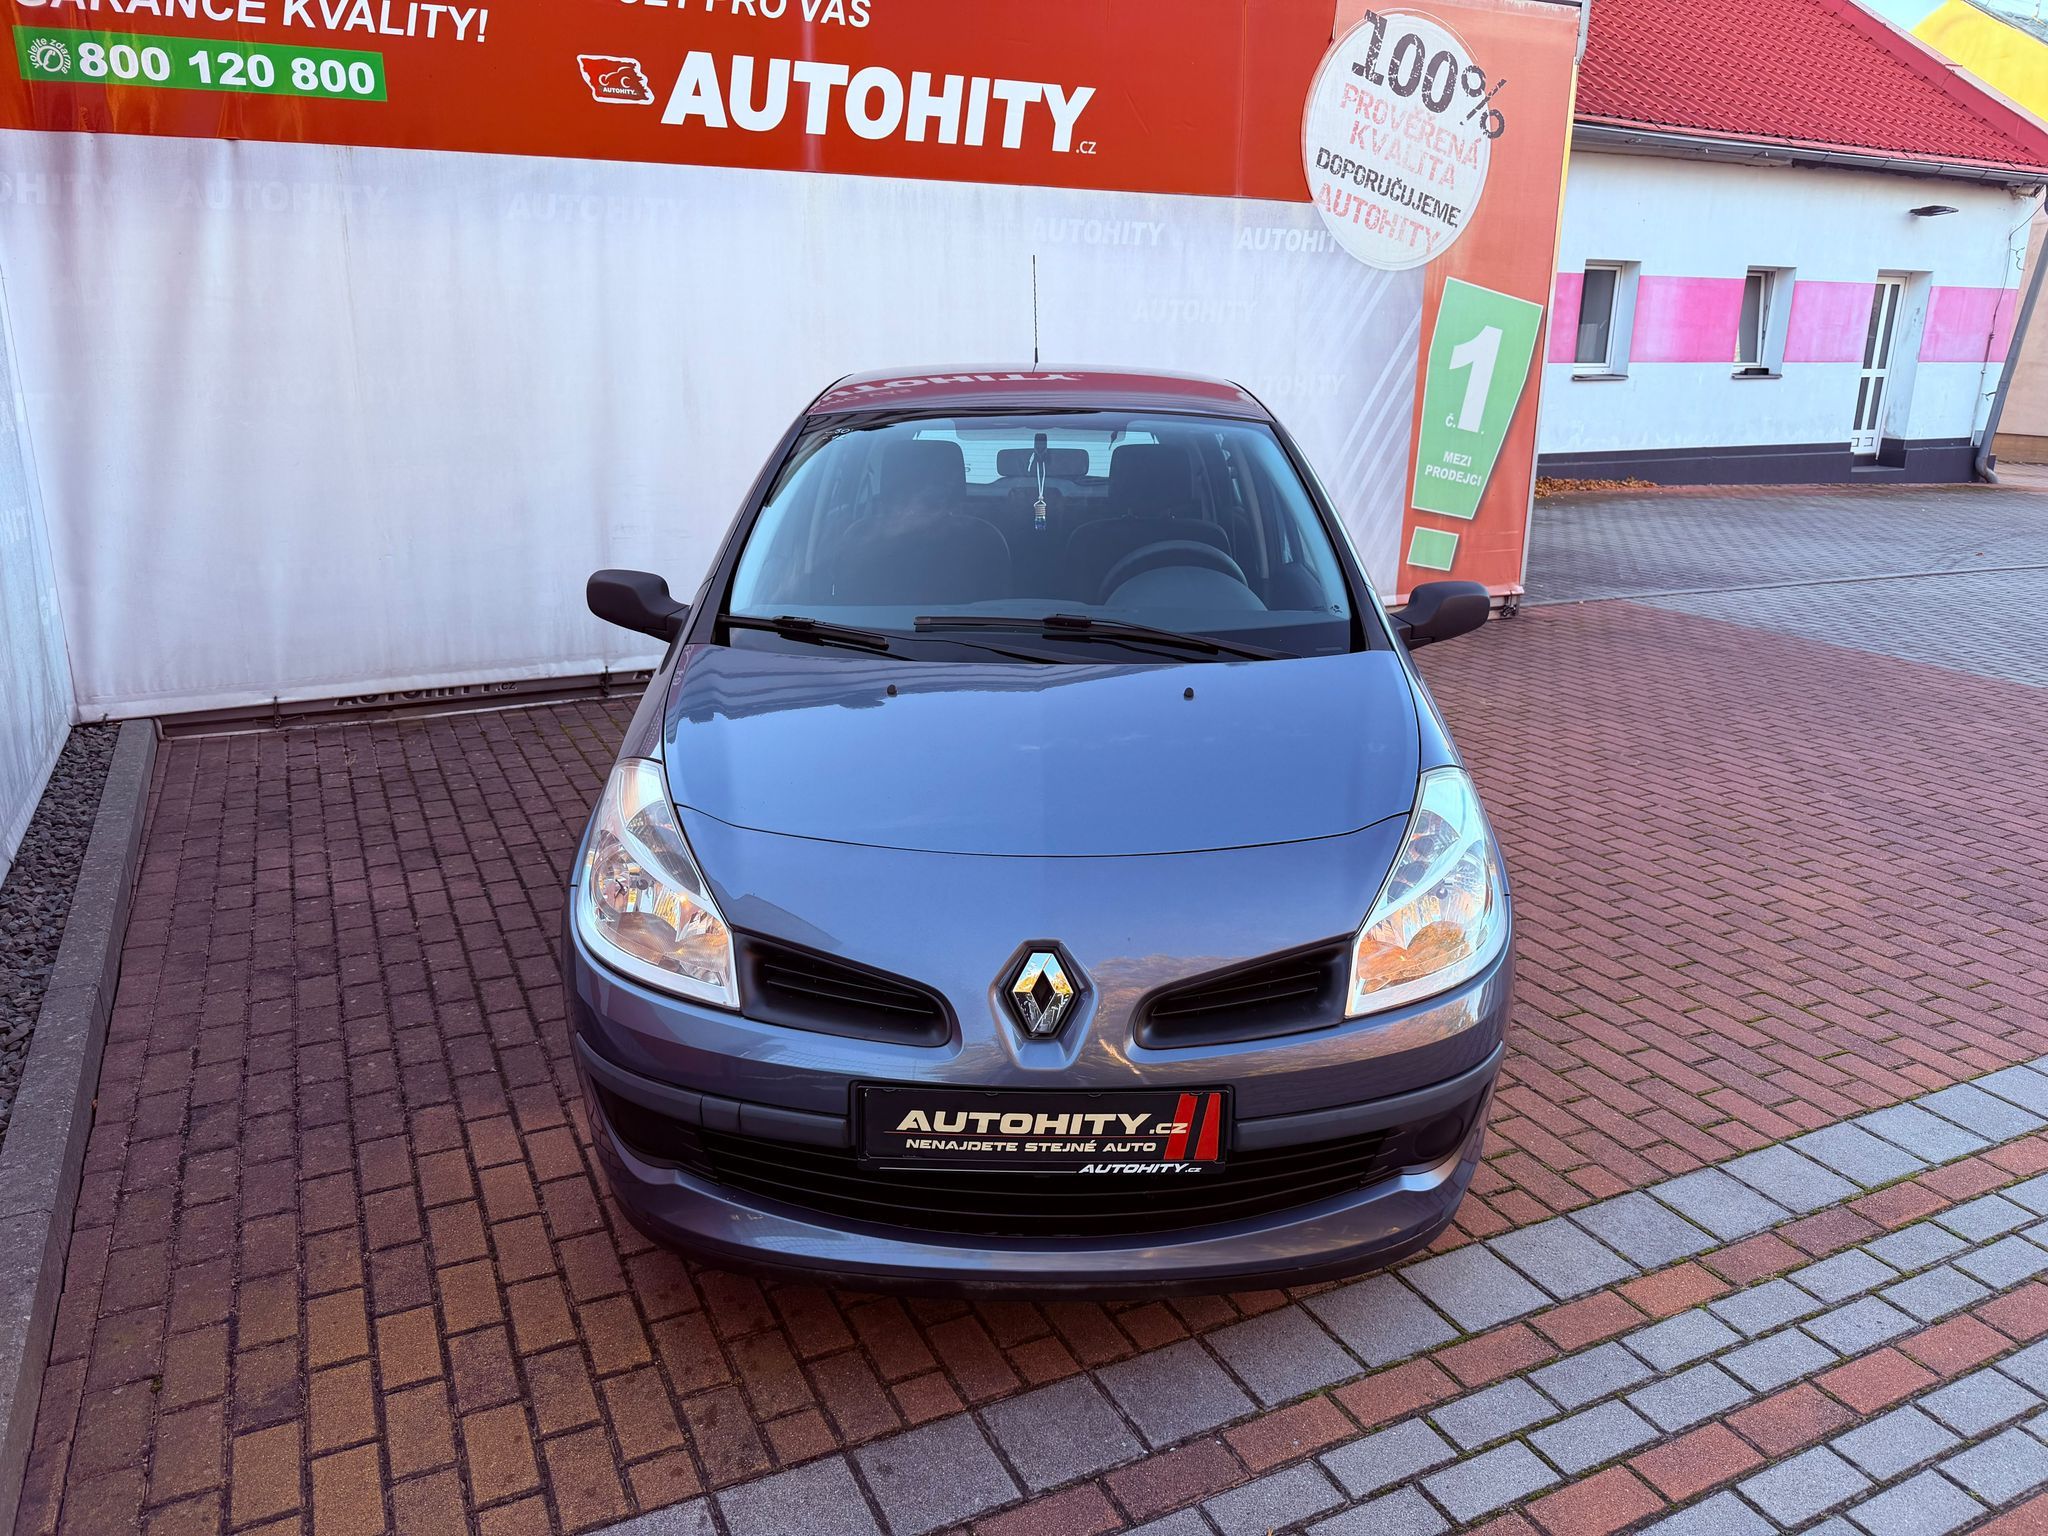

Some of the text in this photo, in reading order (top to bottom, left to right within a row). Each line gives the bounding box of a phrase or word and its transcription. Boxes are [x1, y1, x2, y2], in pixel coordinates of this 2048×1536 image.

[282, 0, 488, 43] KVALITY!
[78, 42, 375, 95] 800 120 800
[1351, 9, 1507, 139] 100%
[1349, 120, 1456, 190] KVALITA
[1316, 147, 1461, 228] DOPORUČUJEME
[1031, 217, 1166, 247] AUTOHITY
[1317, 183, 1441, 255] AUTOHITY
[1425, 464, 1482, 487] PRODEJCI
[1442, 450, 1472, 468] MEZI
[905, 1138, 1157, 1153] NENAJDETE STEJNÉ AUTO
